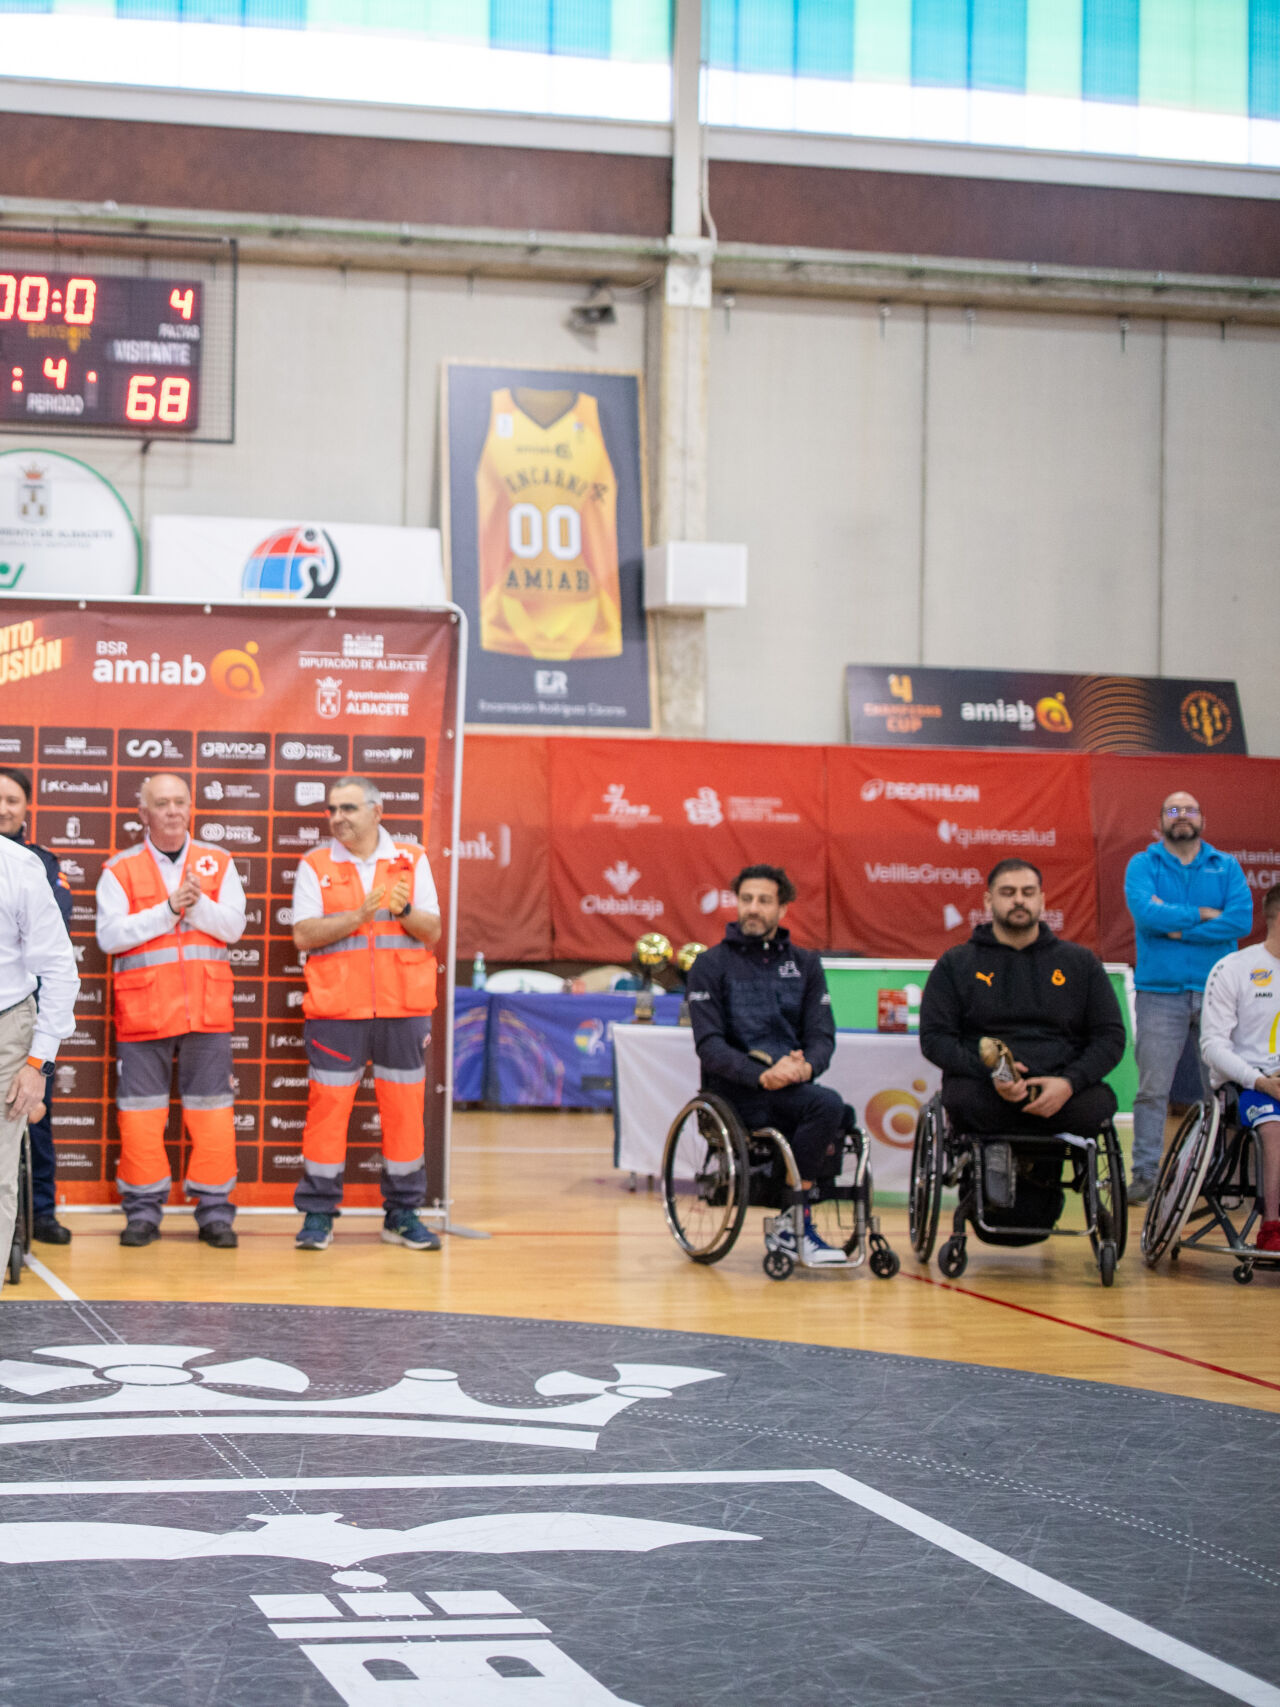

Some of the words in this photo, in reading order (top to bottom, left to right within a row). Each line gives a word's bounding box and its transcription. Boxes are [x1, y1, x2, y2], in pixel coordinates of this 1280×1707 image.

[170, 288, 194, 320] 4
[113, 339, 192, 367] VISITANTE
[43, 357, 68, 390] 4
[125, 374, 191, 423] 68
[509, 502, 582, 561] 00
[506, 567, 591, 593] AMIAB
[96, 640, 128, 656] BSR
[92, 652, 207, 686] amiab
[346, 702, 410, 717] ALBACETE
[961, 699, 1035, 724] amiab
[201, 741, 266, 758] gaviota
[885, 782, 980, 802] DECATHLON
